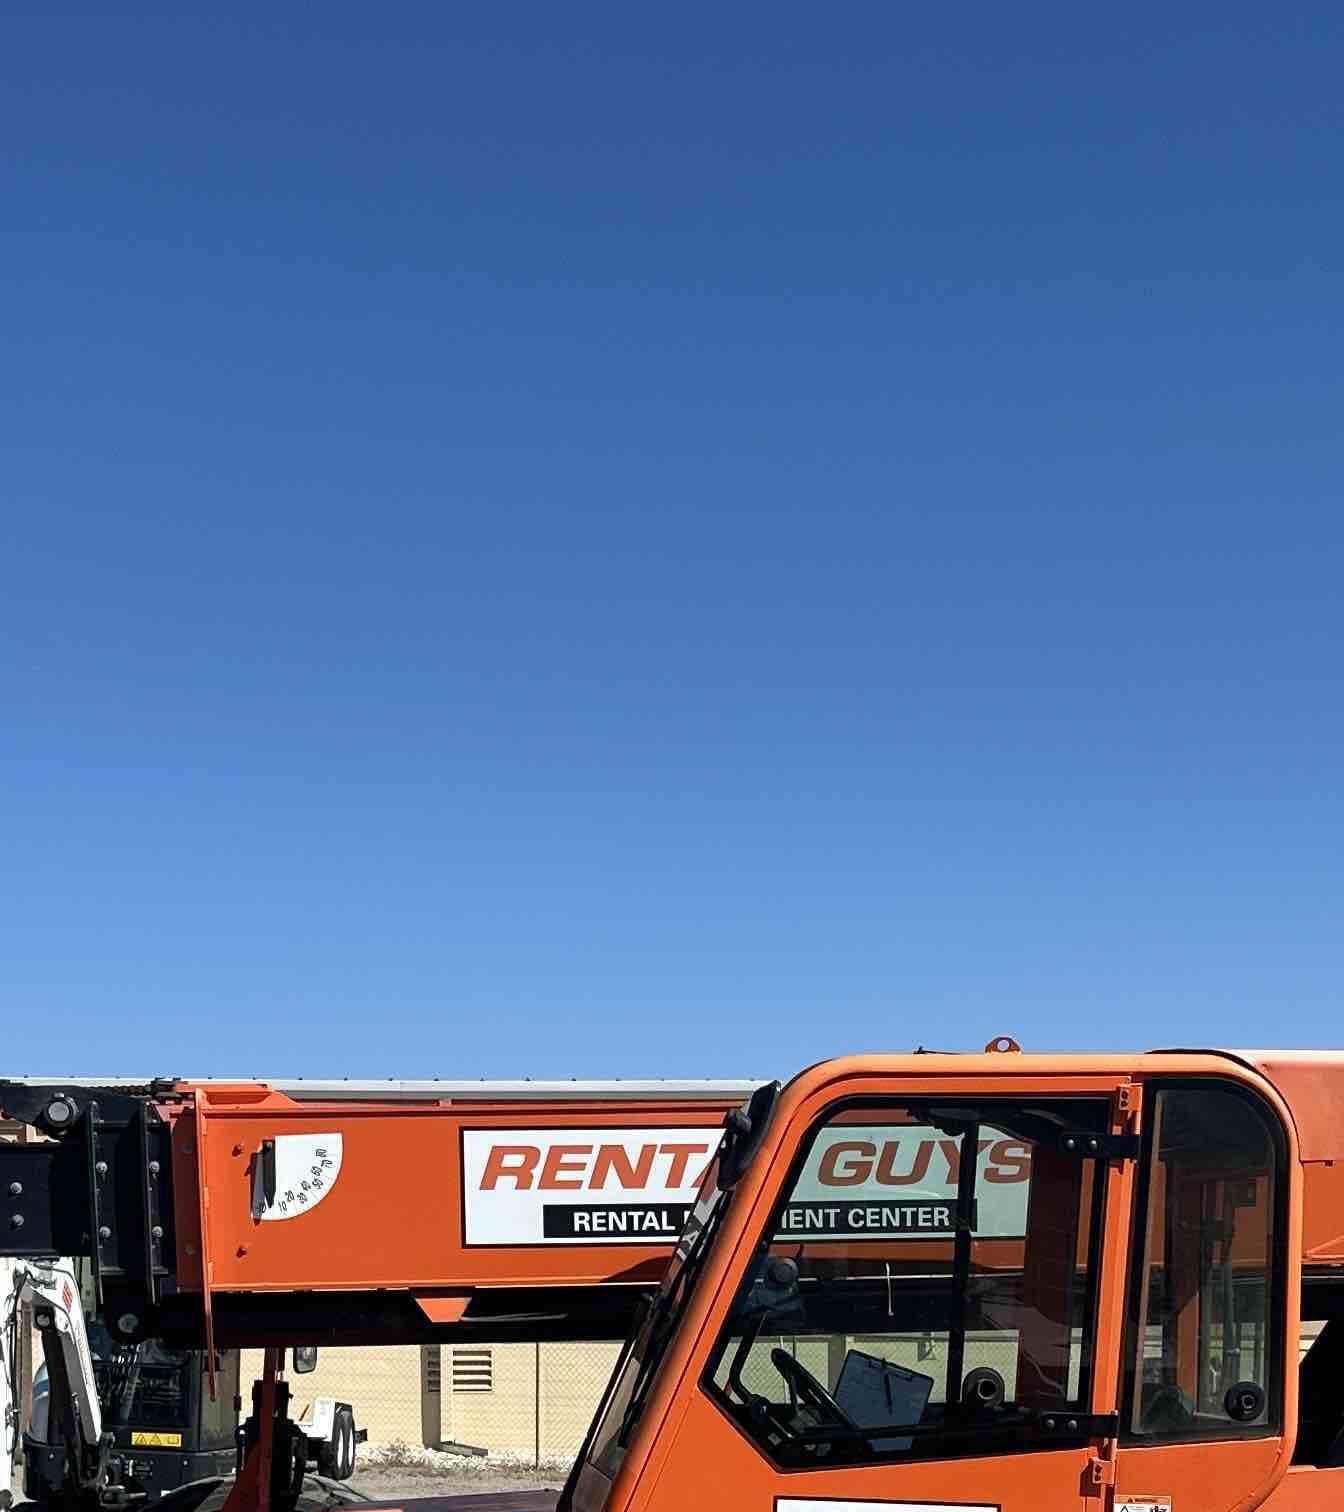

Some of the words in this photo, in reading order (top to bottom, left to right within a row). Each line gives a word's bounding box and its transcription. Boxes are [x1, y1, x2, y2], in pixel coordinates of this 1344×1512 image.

[479, 1144, 712, 1190] RENT
[817, 1140, 1032, 1187] GUYS
[573, 1210, 676, 1232] RENTAL
[847, 1206, 950, 1229] CENTER
